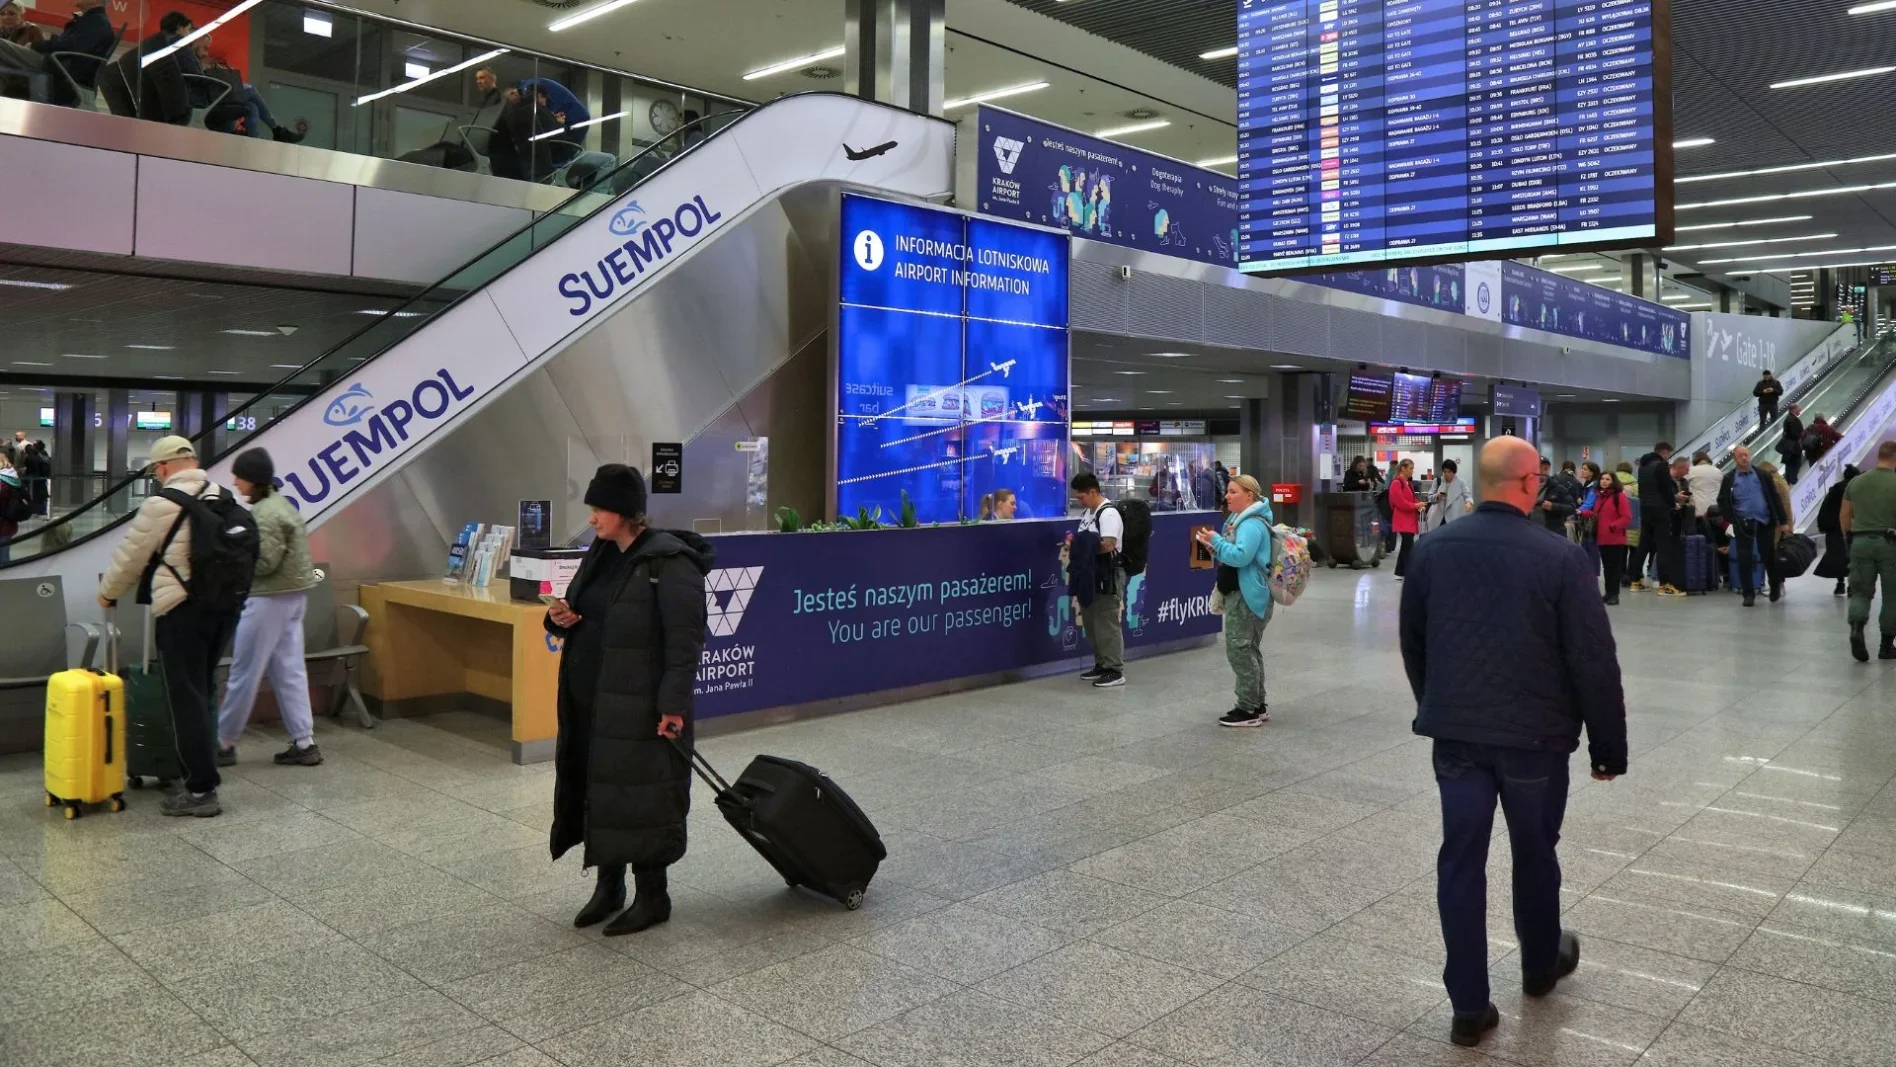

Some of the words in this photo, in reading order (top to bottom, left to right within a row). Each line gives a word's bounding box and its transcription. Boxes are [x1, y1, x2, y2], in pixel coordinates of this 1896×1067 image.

[992, 177, 1020, 190] KRAKÓW
[992, 186, 1020, 199] AIRPORT
[558, 195, 721, 316] SUEMPOL
[895, 234, 974, 263] INFORMACJA
[978, 249, 1050, 275] LOTNISKOWA
[894, 264, 948, 285] AIRPORT
[951, 271, 1031, 296] INFORMATION
[1736, 331, 1757, 369] Gate
[1759, 339, 1776, 373] 1-18
[237, 416, 256, 431] 38
[793, 584, 857, 614] Jesteś
[865, 582, 933, 609] naszym
[940, 568, 1032, 605] pasażerem!
[827, 619, 864, 645] You
[871, 619, 901, 639] are
[907, 613, 939, 634] our
[945, 597, 1032, 636] passenger!
[698, 643, 755, 665] RAKÓW
[706, 684, 723, 694] Jana
